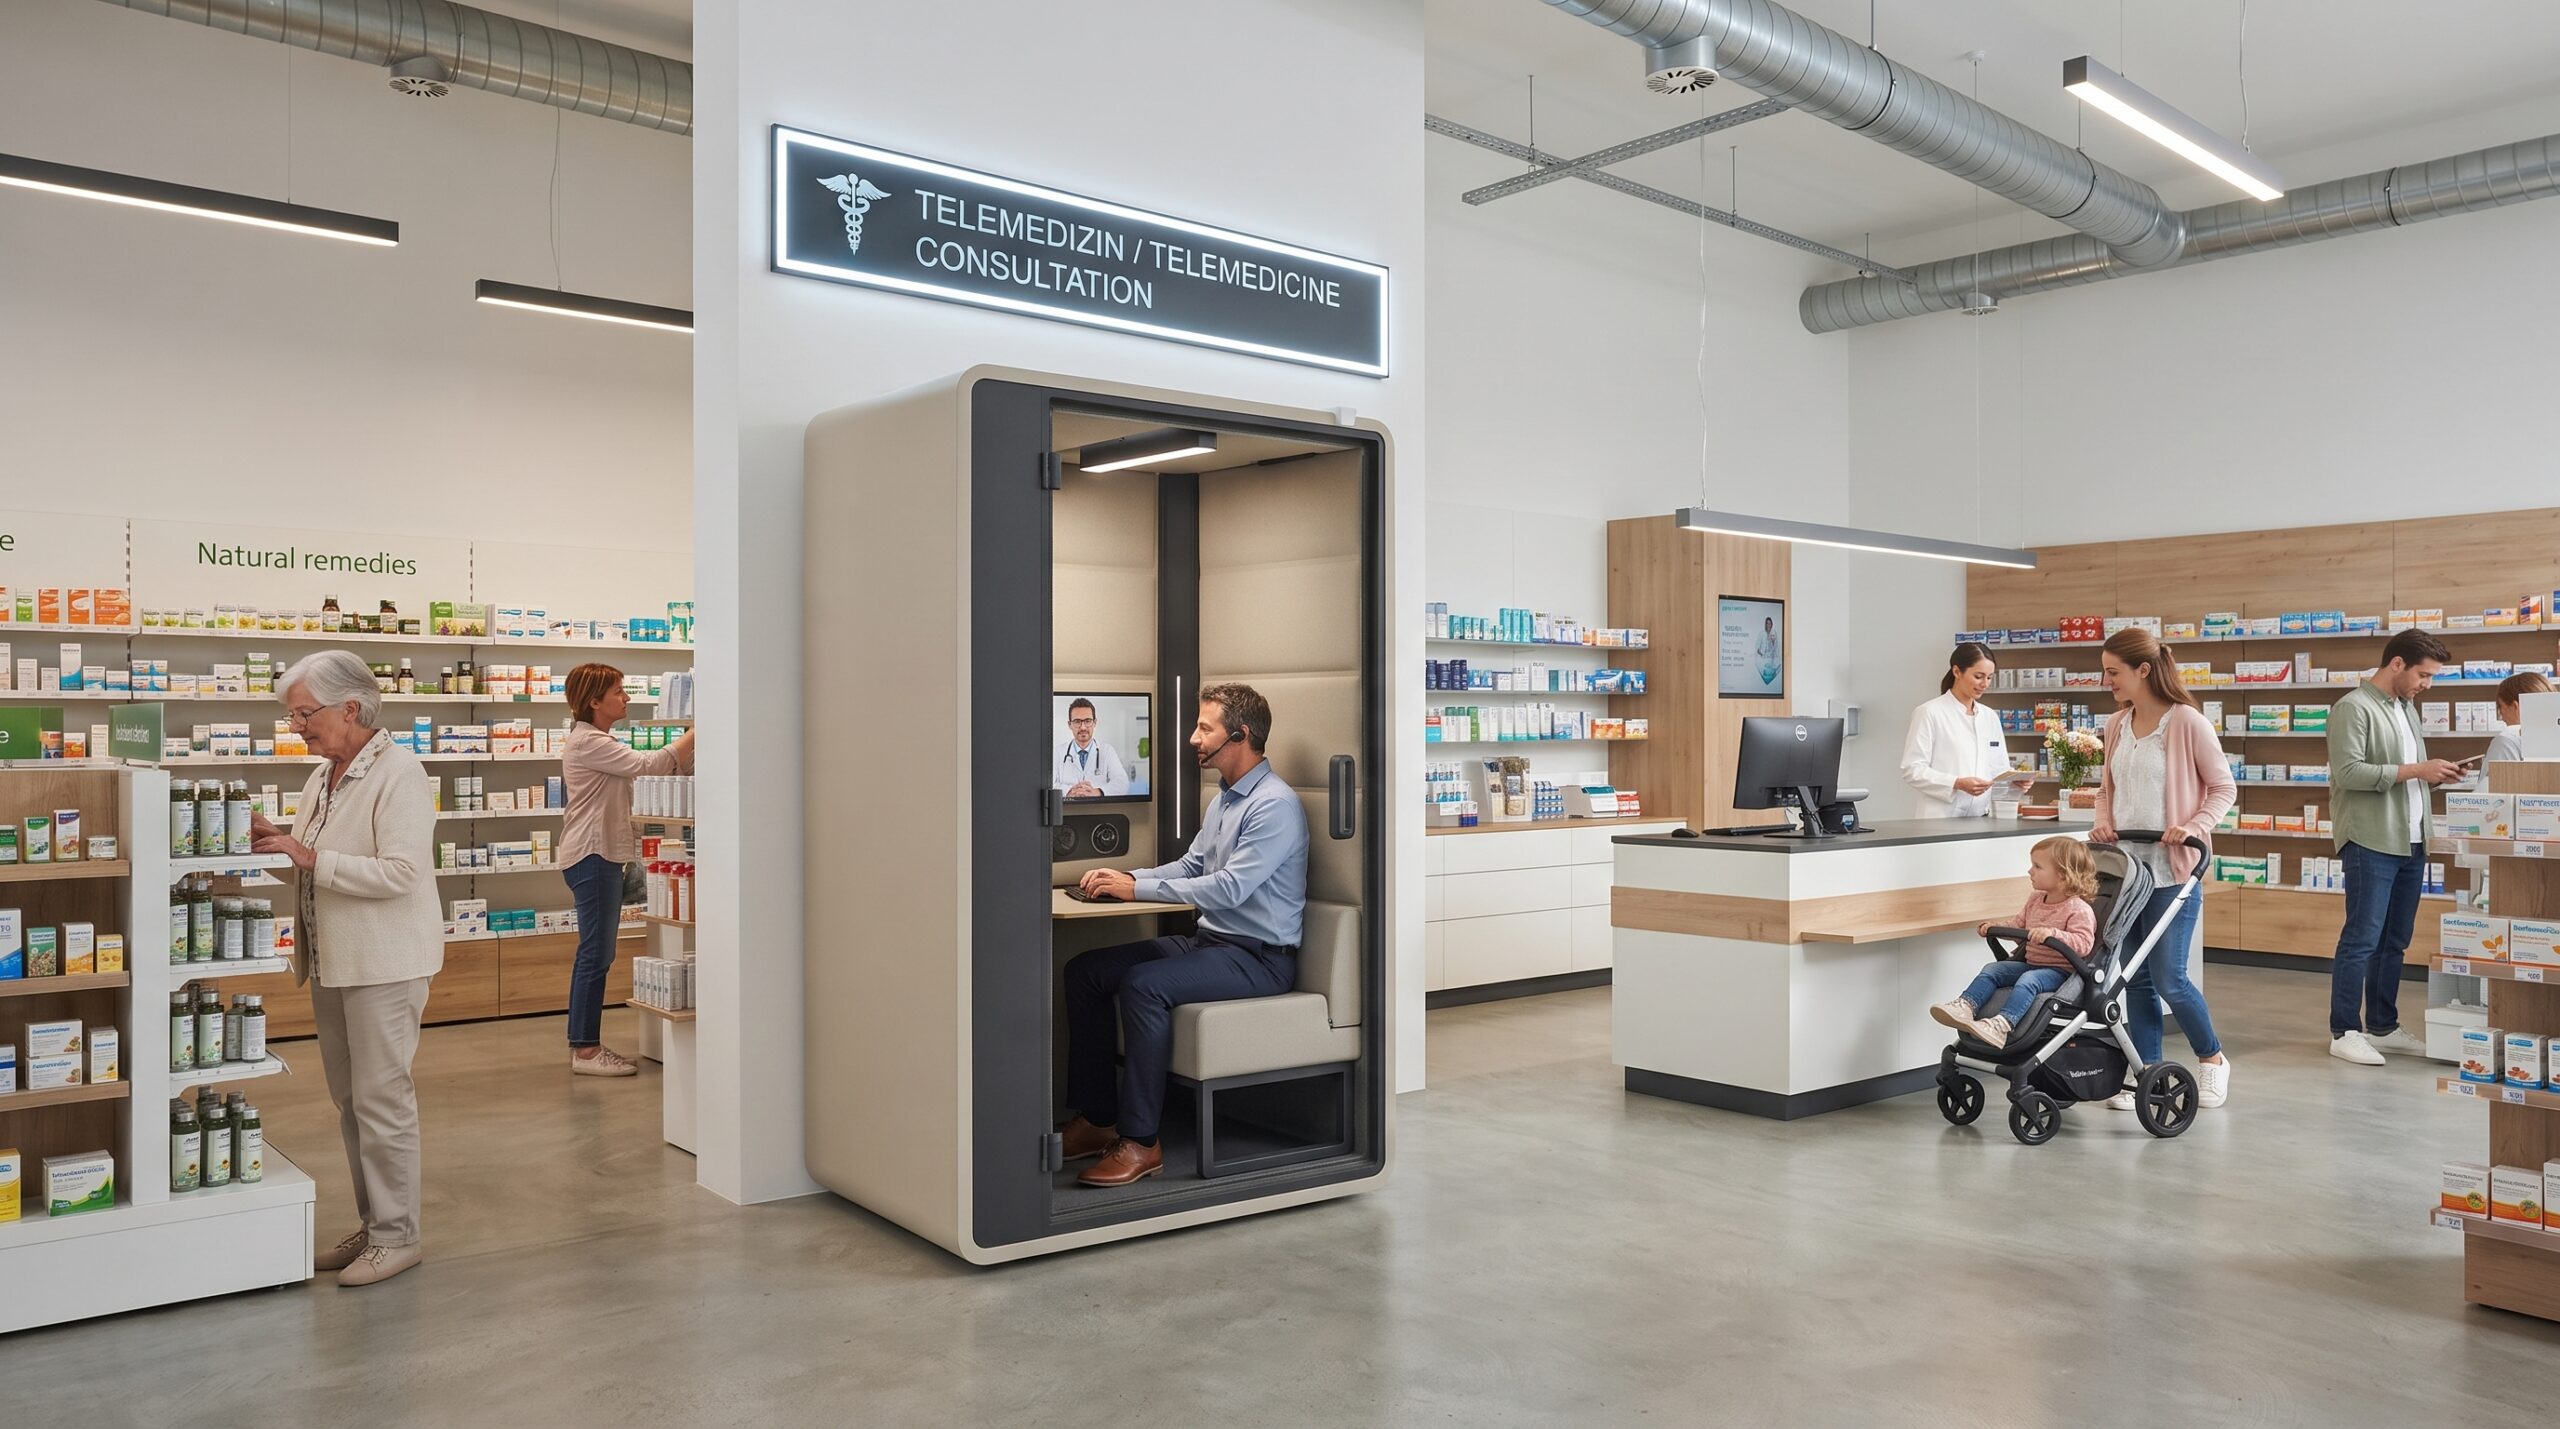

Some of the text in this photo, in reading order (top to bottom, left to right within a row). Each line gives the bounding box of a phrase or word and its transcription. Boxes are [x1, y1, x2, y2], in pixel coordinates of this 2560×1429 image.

[915, 189, 1340, 308] TELEMEDIZIN / TELEMEDICINE
[916, 236, 1152, 309] CONSULTATION
[198, 542, 417, 575] Natural remedies
